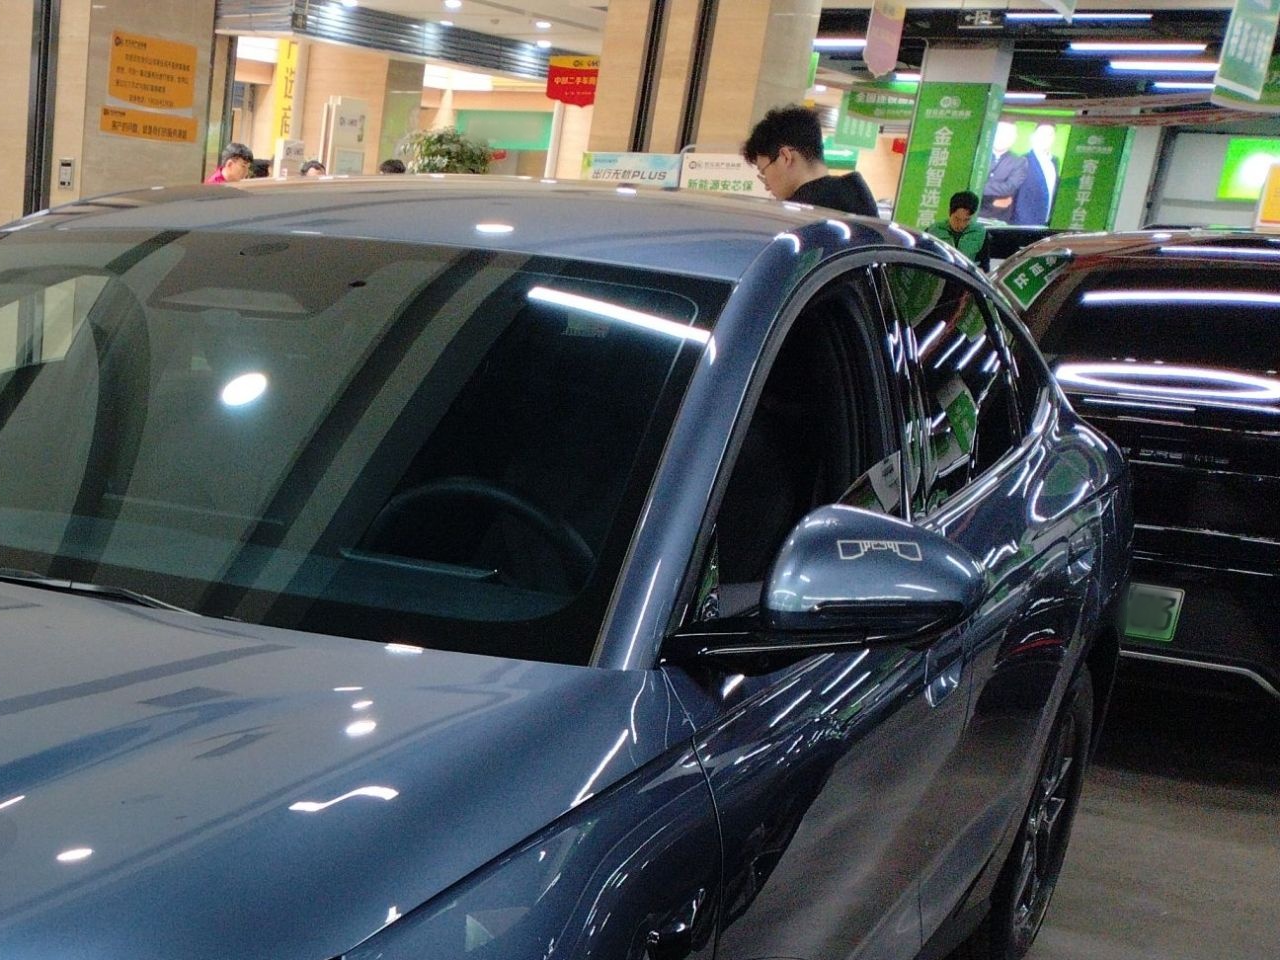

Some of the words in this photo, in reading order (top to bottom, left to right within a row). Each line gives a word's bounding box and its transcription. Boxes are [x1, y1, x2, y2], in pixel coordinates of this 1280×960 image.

[687, 178, 754, 192] 新能源安芯保
